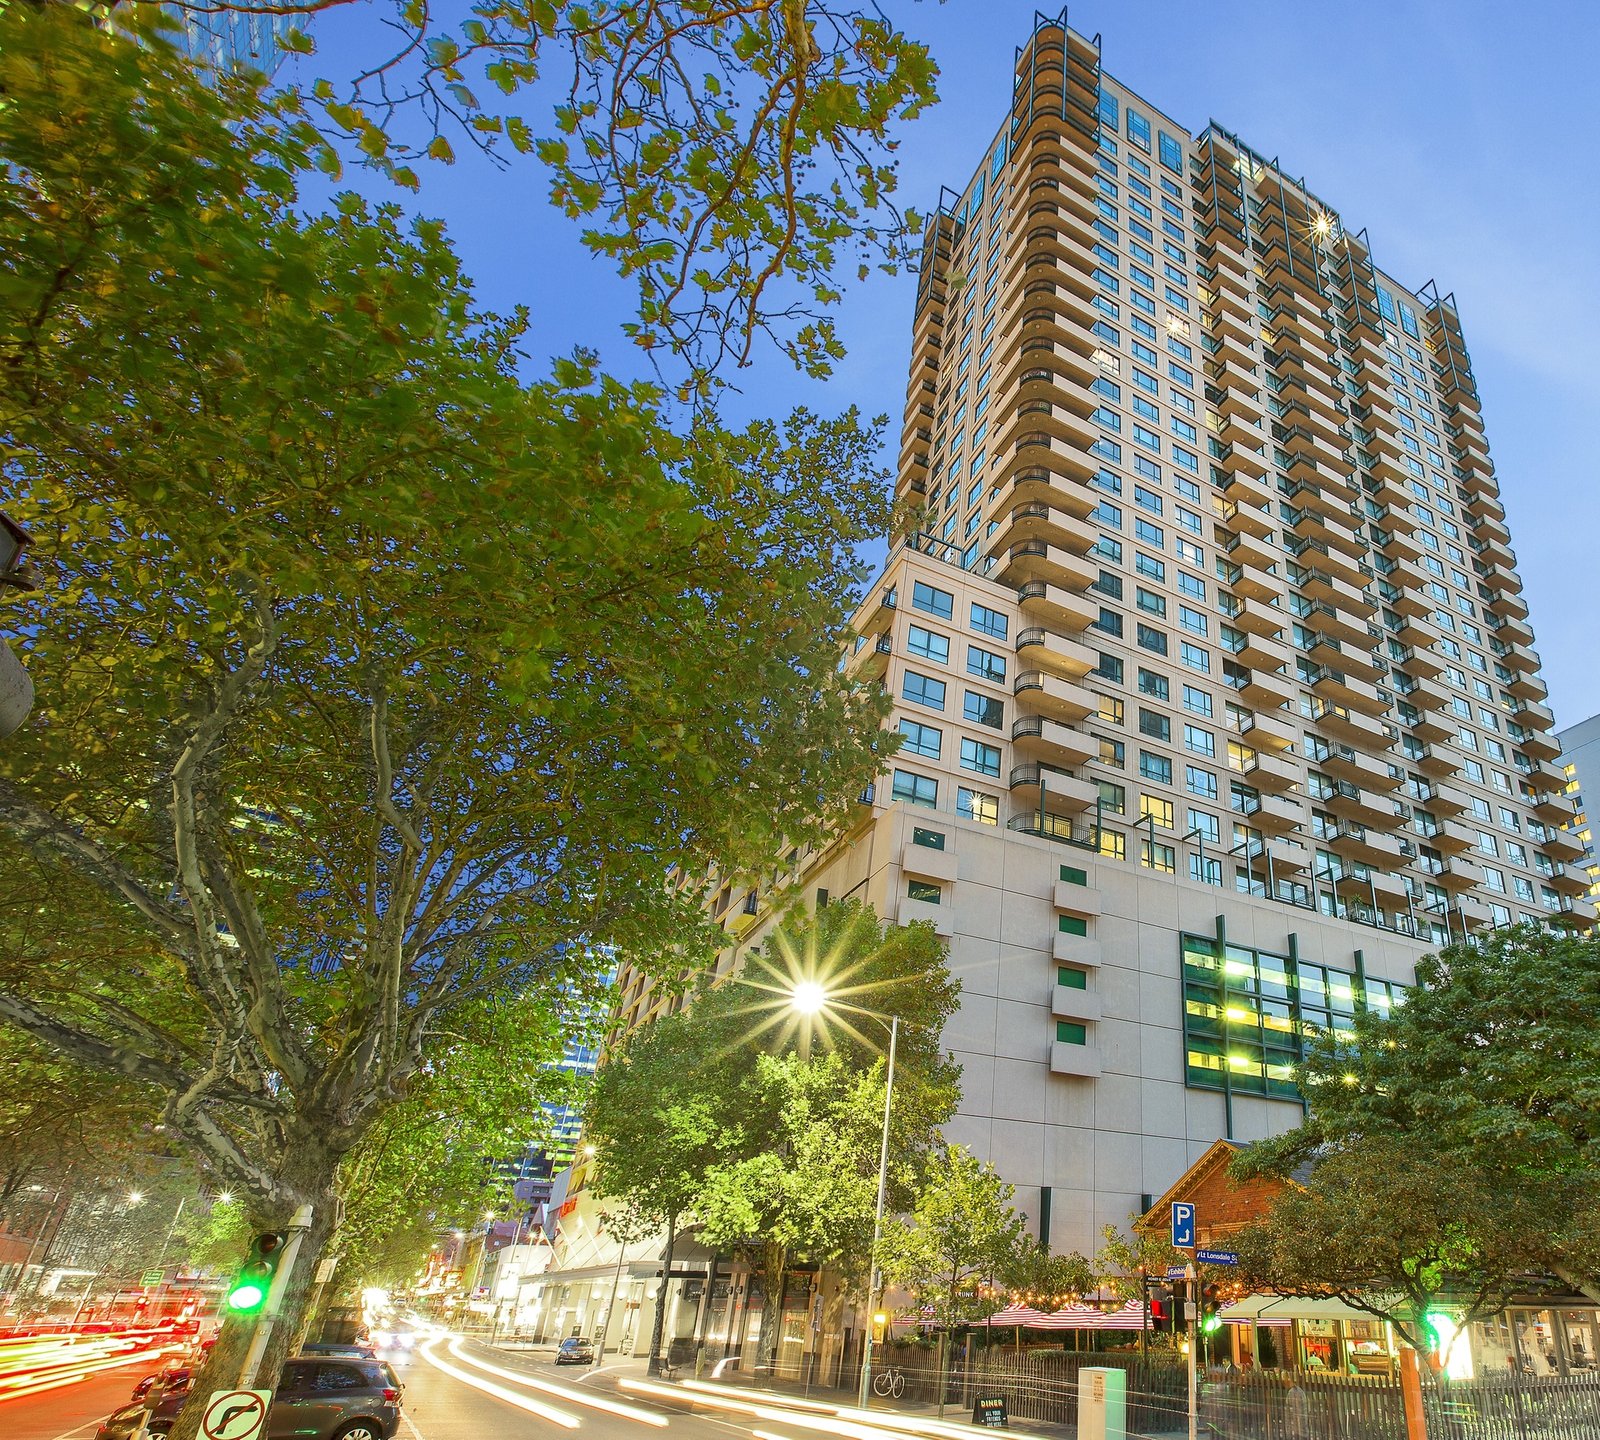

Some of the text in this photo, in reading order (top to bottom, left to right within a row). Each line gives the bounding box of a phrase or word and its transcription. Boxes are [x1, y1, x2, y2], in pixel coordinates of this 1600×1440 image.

[1177, 1206, 1190, 1225] P
[1207, 1252, 1231, 1261] Lonsdale
[980, 1399, 1004, 1408] DINER
